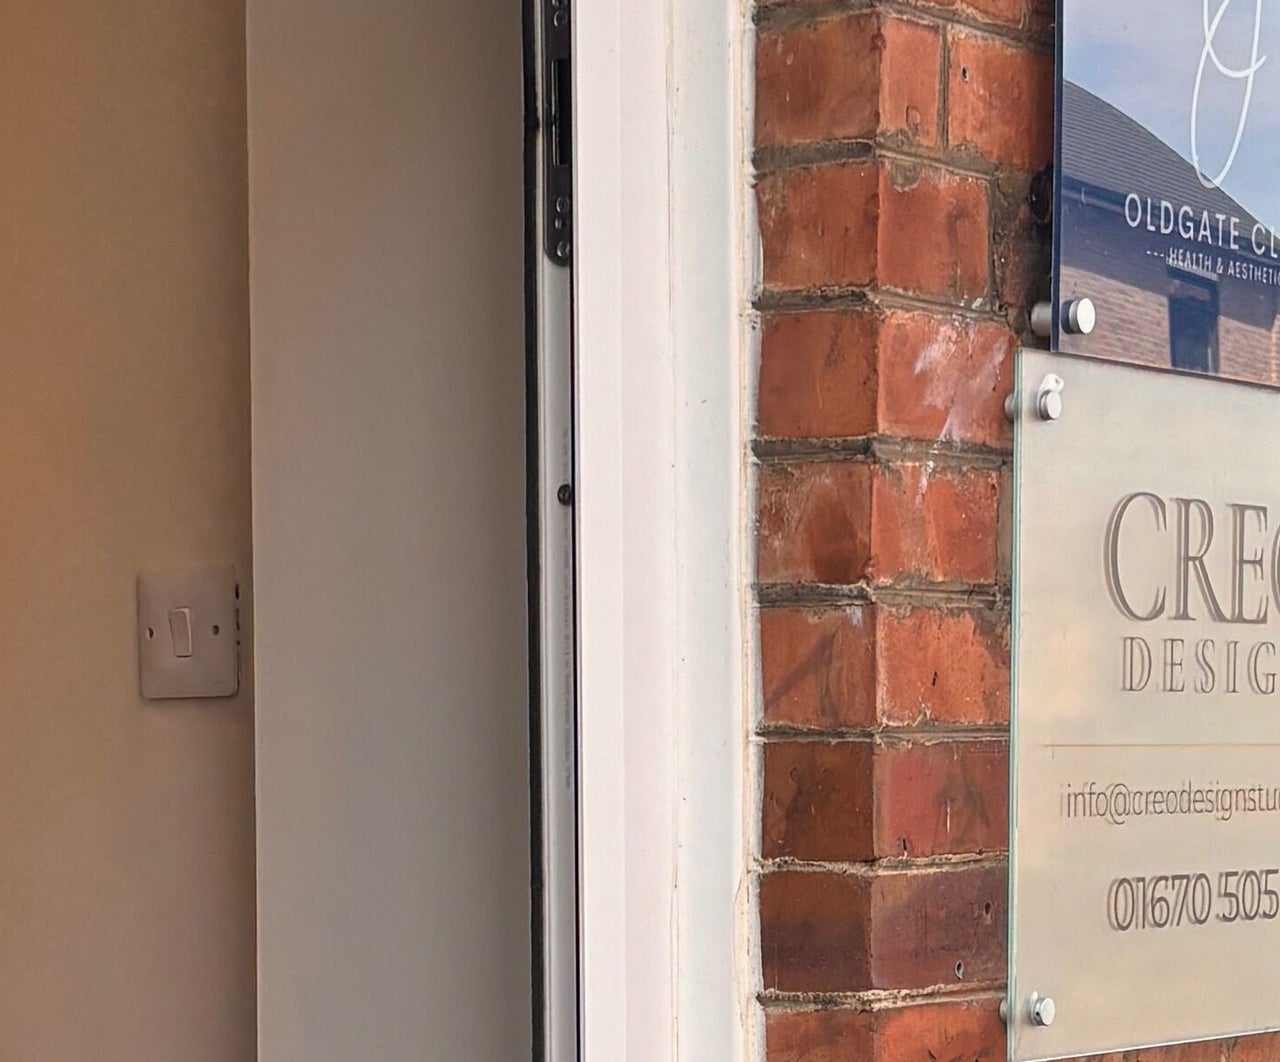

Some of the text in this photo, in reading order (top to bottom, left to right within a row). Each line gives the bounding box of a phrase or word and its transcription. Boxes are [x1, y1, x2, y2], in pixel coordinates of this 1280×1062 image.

[1124, 193, 1240, 250] OLDGATE
[1169, 247, 1212, 272] HEALTH
[1216, 256, 1224, 274] &
[1109, 872, 1212, 931] 01670
[1217, 868, 1280, 923] 505
